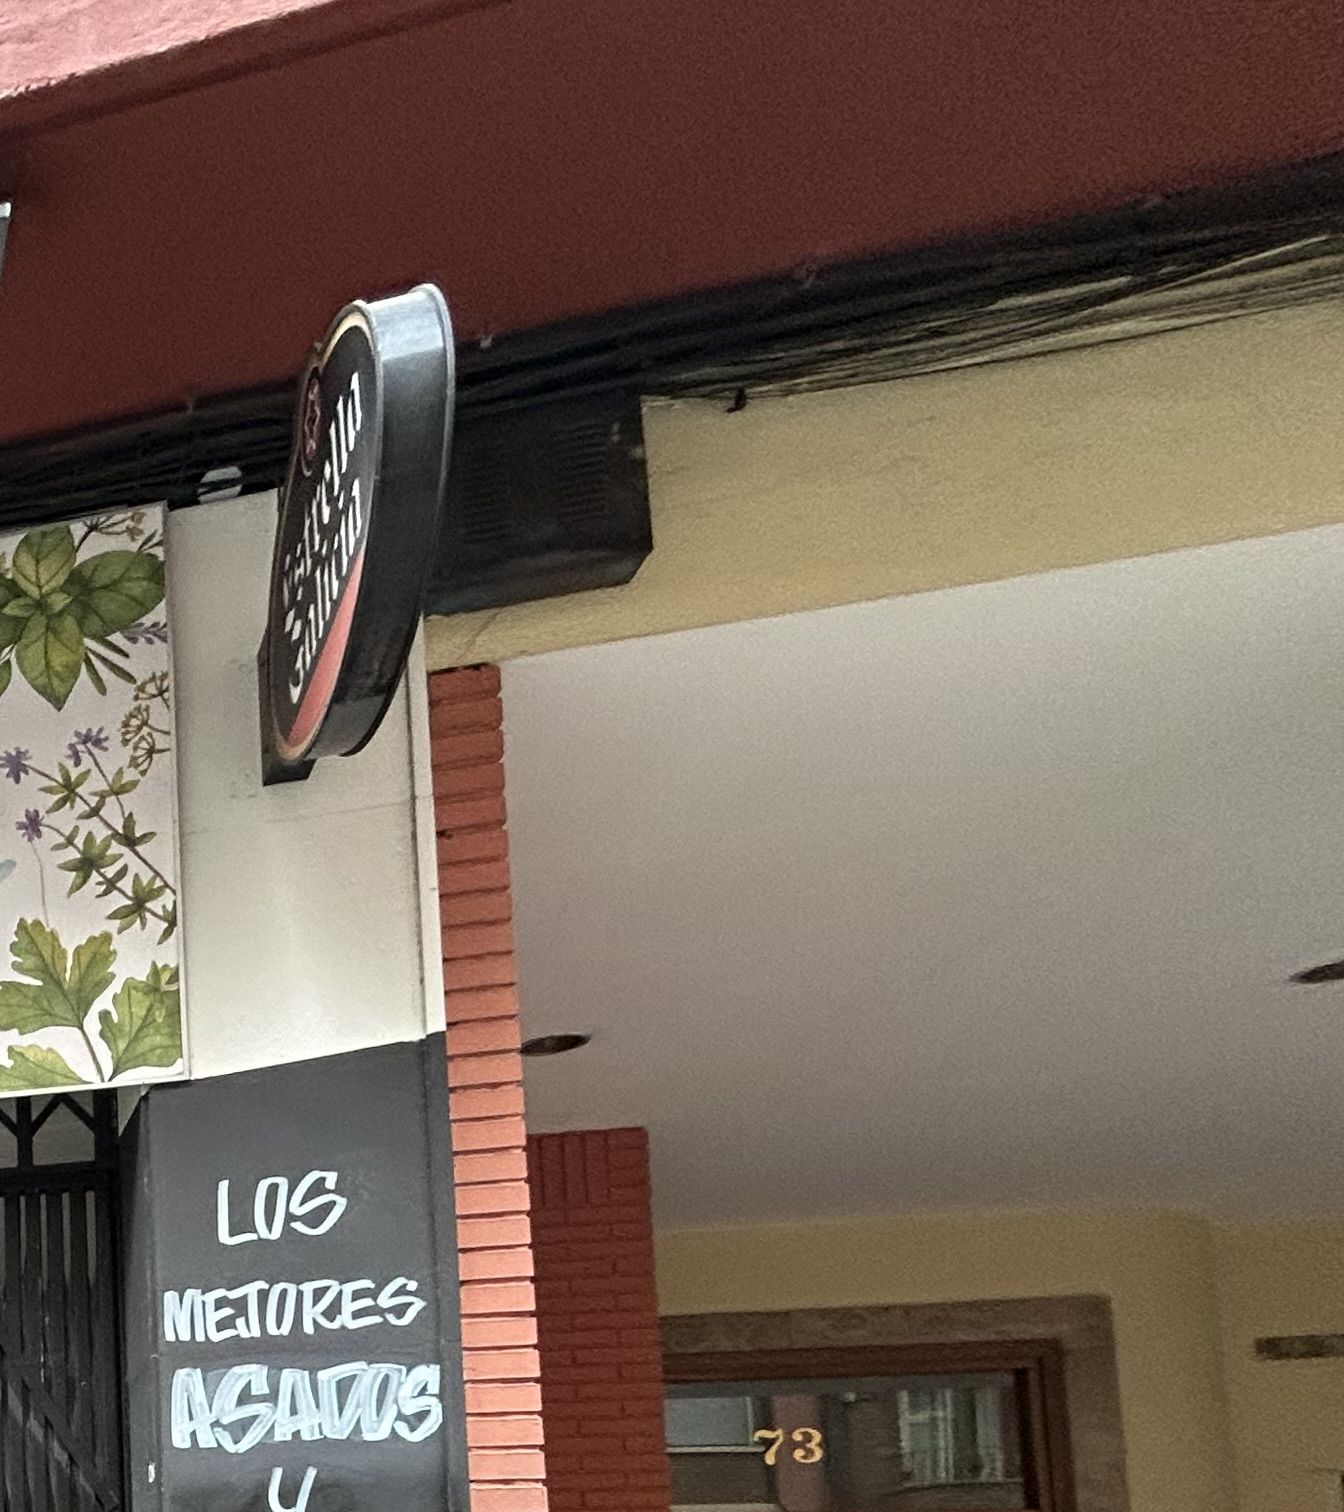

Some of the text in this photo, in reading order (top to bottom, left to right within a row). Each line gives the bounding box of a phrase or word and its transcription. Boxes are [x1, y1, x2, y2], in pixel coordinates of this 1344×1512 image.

[216, 1169, 347, 1246] LOS
[162, 1276, 427, 1343] MEJORES
[171, 1361, 443, 1453] ASADOS
[753, 1427, 824, 1466] 73
